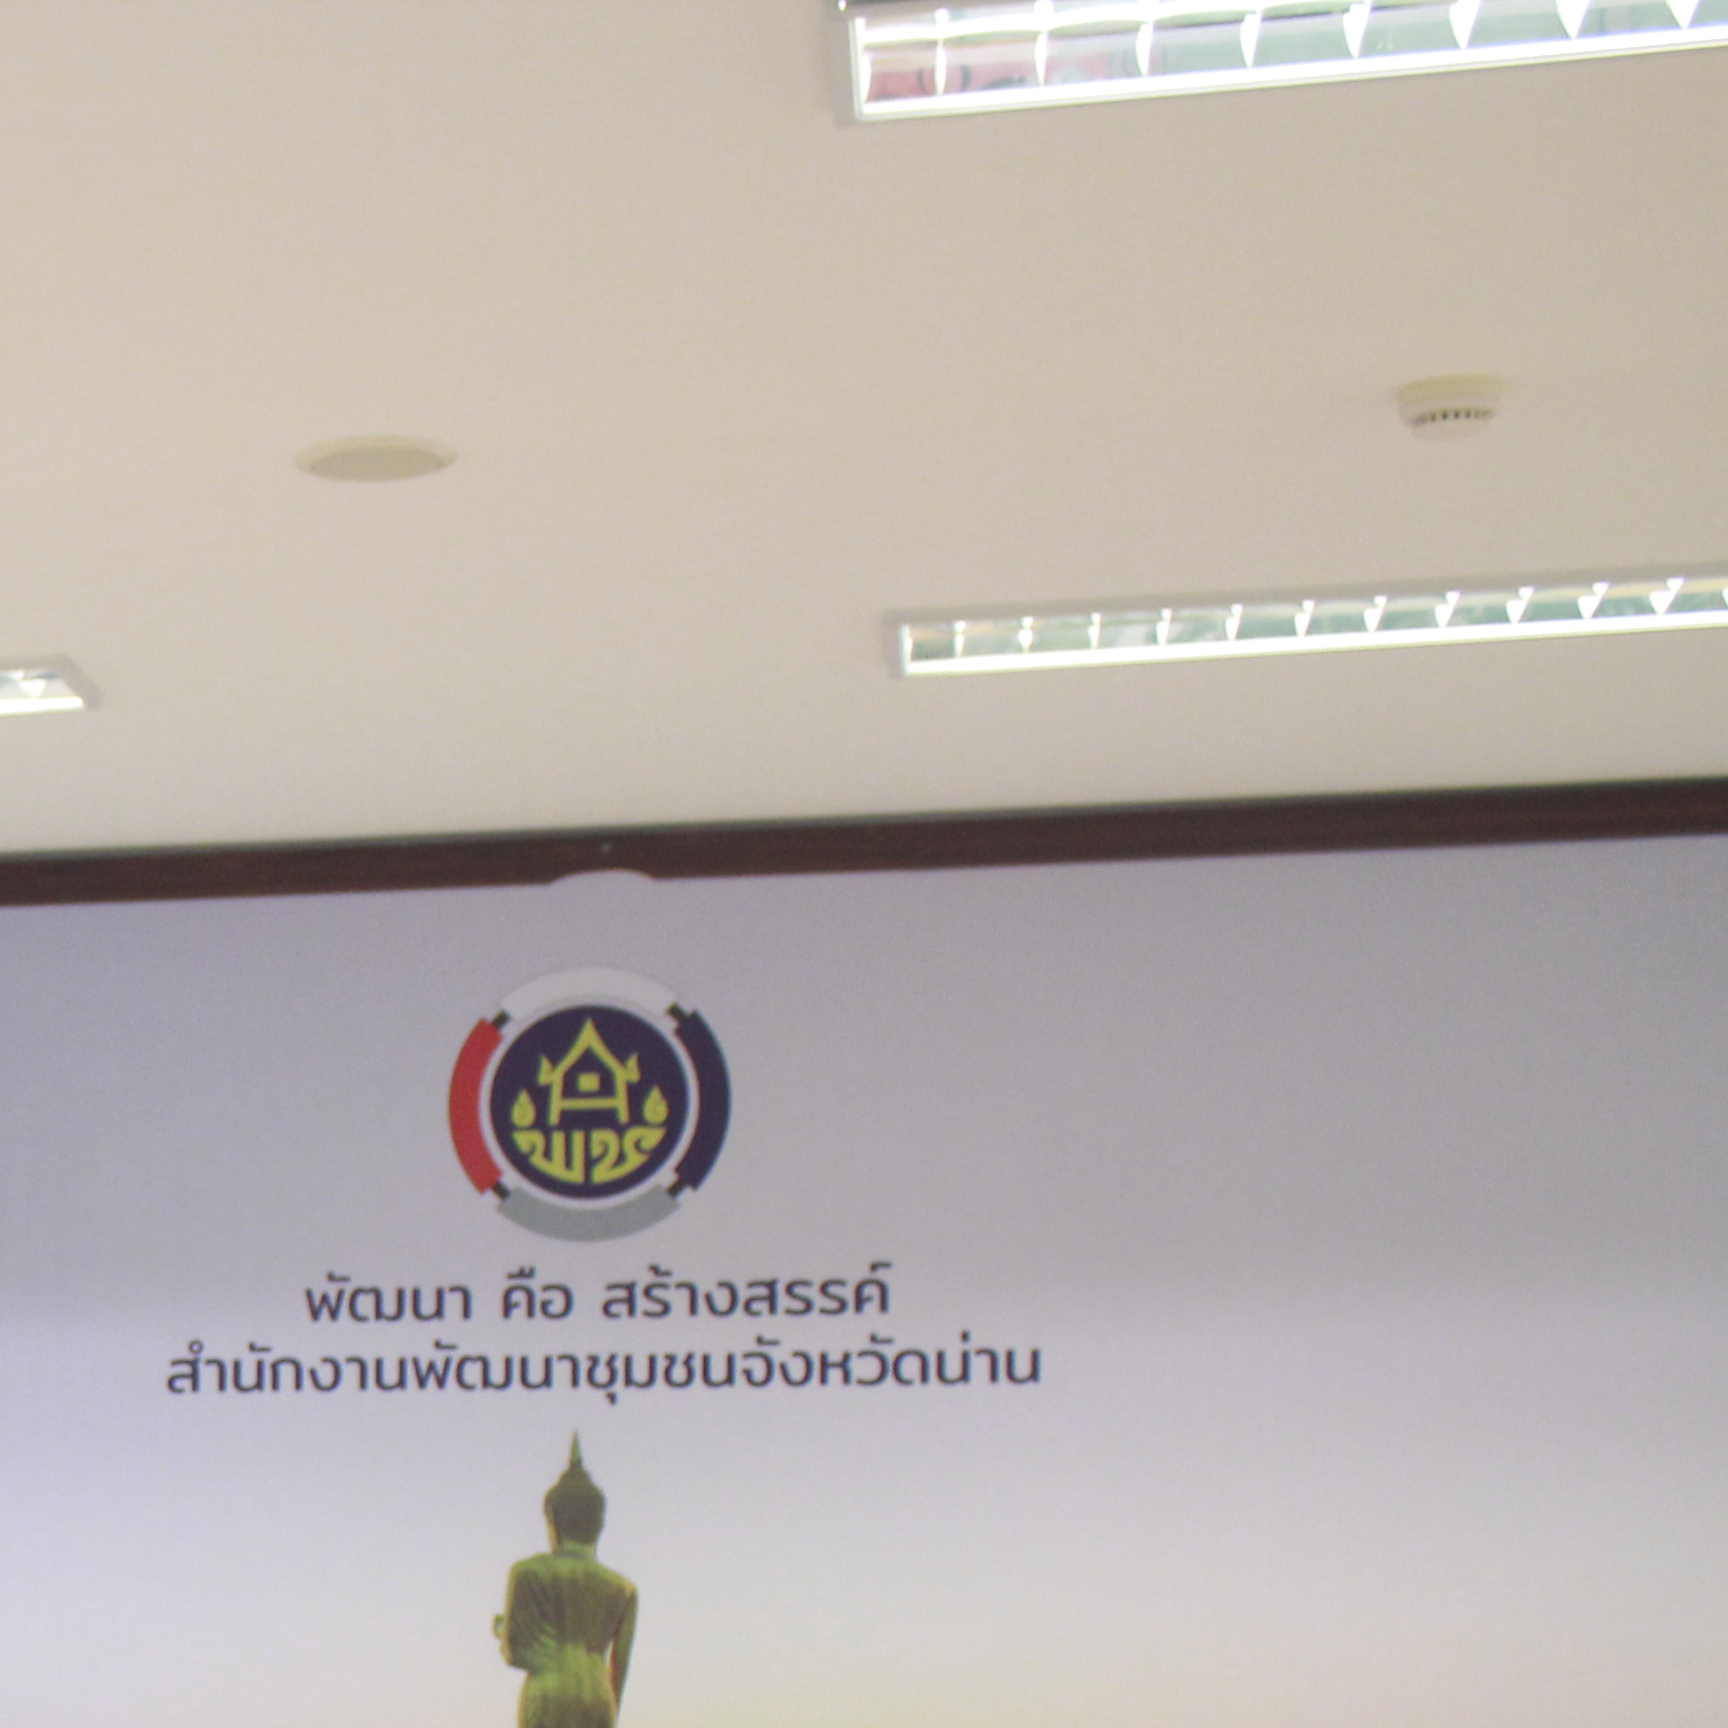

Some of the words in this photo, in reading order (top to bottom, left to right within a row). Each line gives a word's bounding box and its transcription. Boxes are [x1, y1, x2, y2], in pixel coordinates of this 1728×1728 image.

[306, 1271, 473, 1322] พัฒนา
[502, 1266, 575, 1320] คือ
[601, 1262, 893, 1319] สร้างสรรค์
[166, 1330, 1042, 1404] สำนักงานพัฒนาชุมชนจังหวัดน่าน
